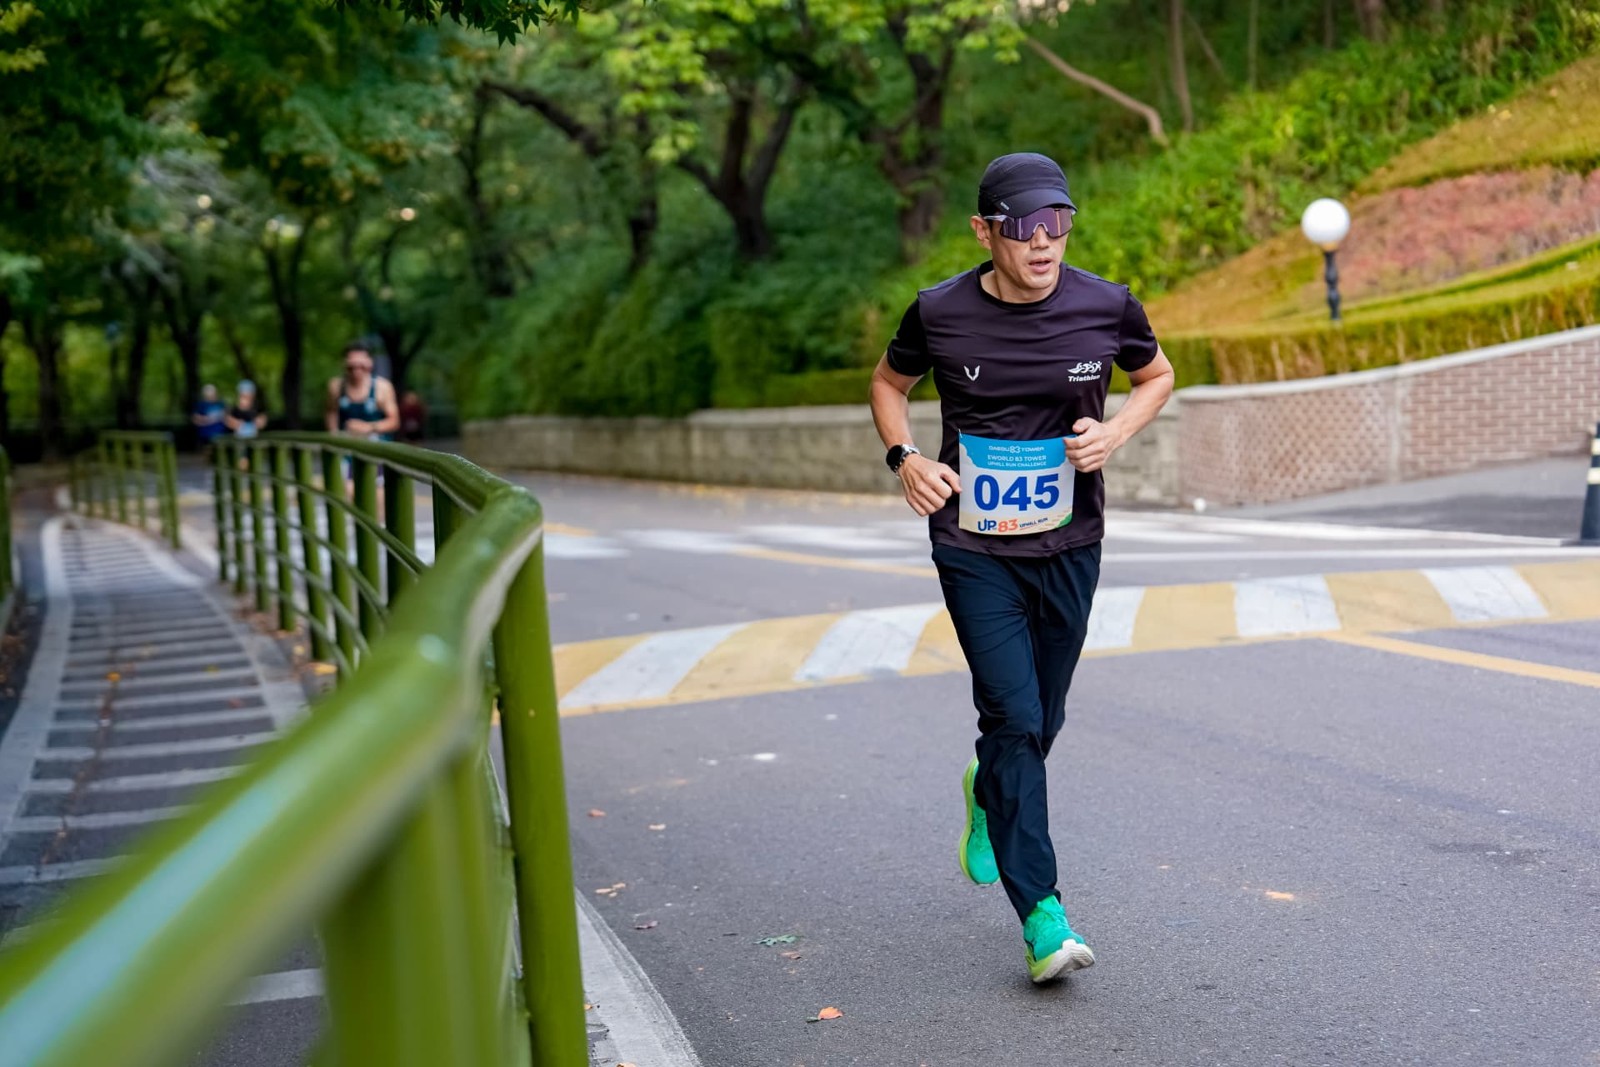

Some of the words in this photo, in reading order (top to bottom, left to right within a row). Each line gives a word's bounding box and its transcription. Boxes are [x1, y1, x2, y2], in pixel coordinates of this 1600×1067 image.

[1068, 374, 1101, 382] Triathlon
[987, 454, 1014, 462] EWORLD
[974, 473, 1060, 511] 045
[997, 518, 1018, 533] 83
